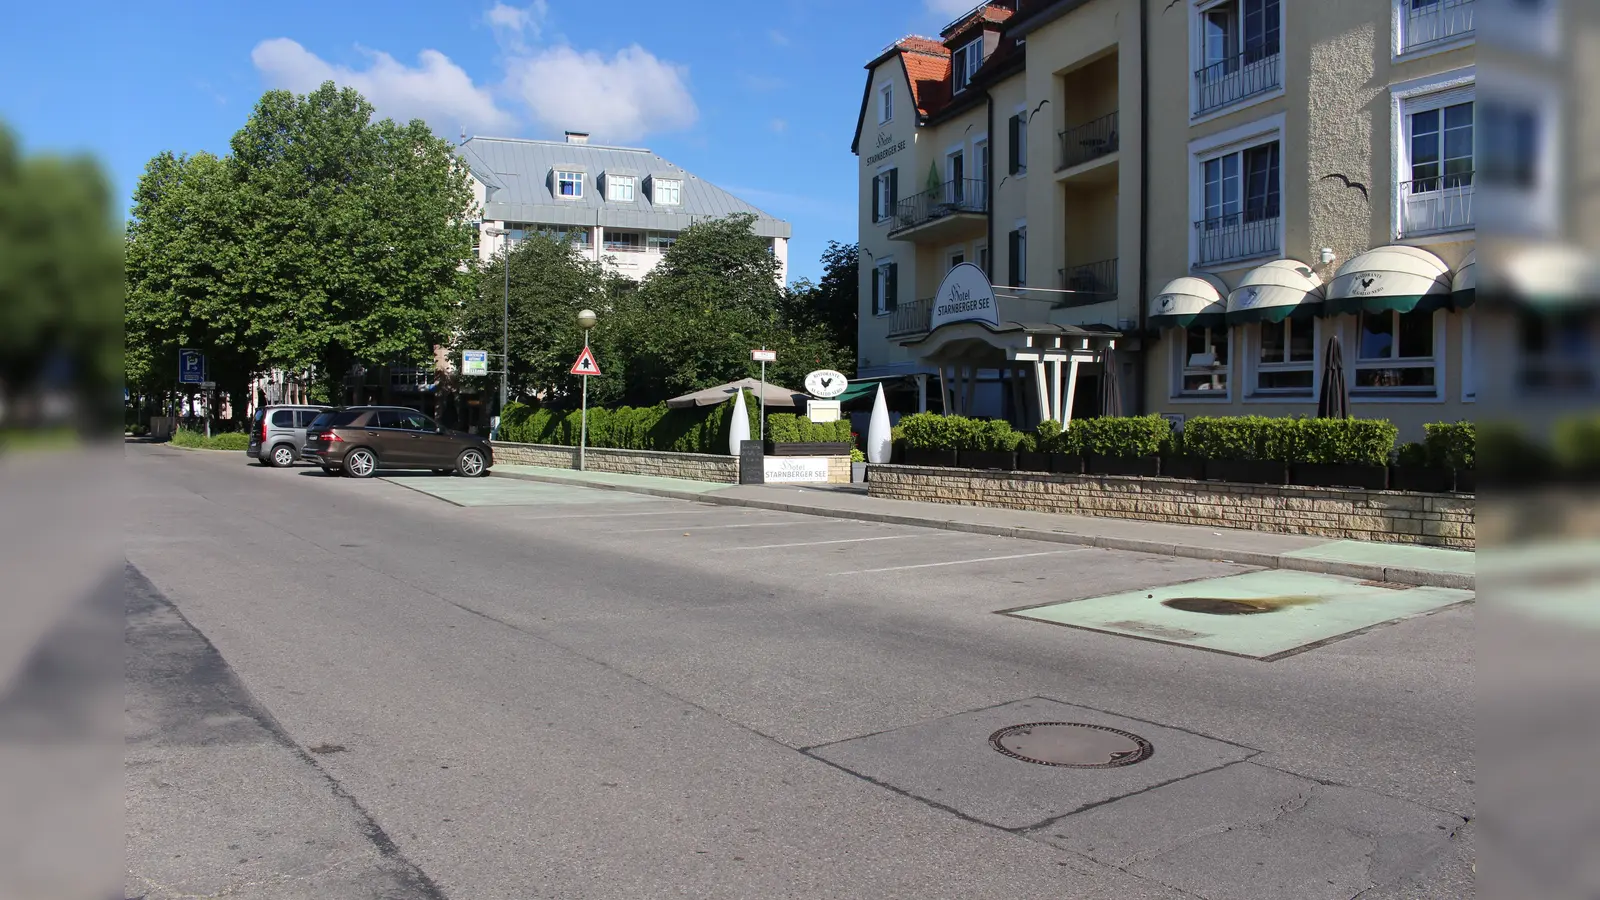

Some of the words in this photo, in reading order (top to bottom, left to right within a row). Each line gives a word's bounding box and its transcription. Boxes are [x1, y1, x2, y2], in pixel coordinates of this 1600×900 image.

[866, 144, 897, 167] STARNBERGER
[897, 140, 906, 152] SEE
[1355, 272, 1382, 281] RISTORANTE
[948, 282, 971, 303] Hotel
[937, 299, 978, 316] STARNBERGER
[978, 297, 990, 310] SEE
[813, 371, 841, 379] RISTORANTE
[765, 470, 813, 478] STARNBERGER
[814, 470, 827, 478] SEE
